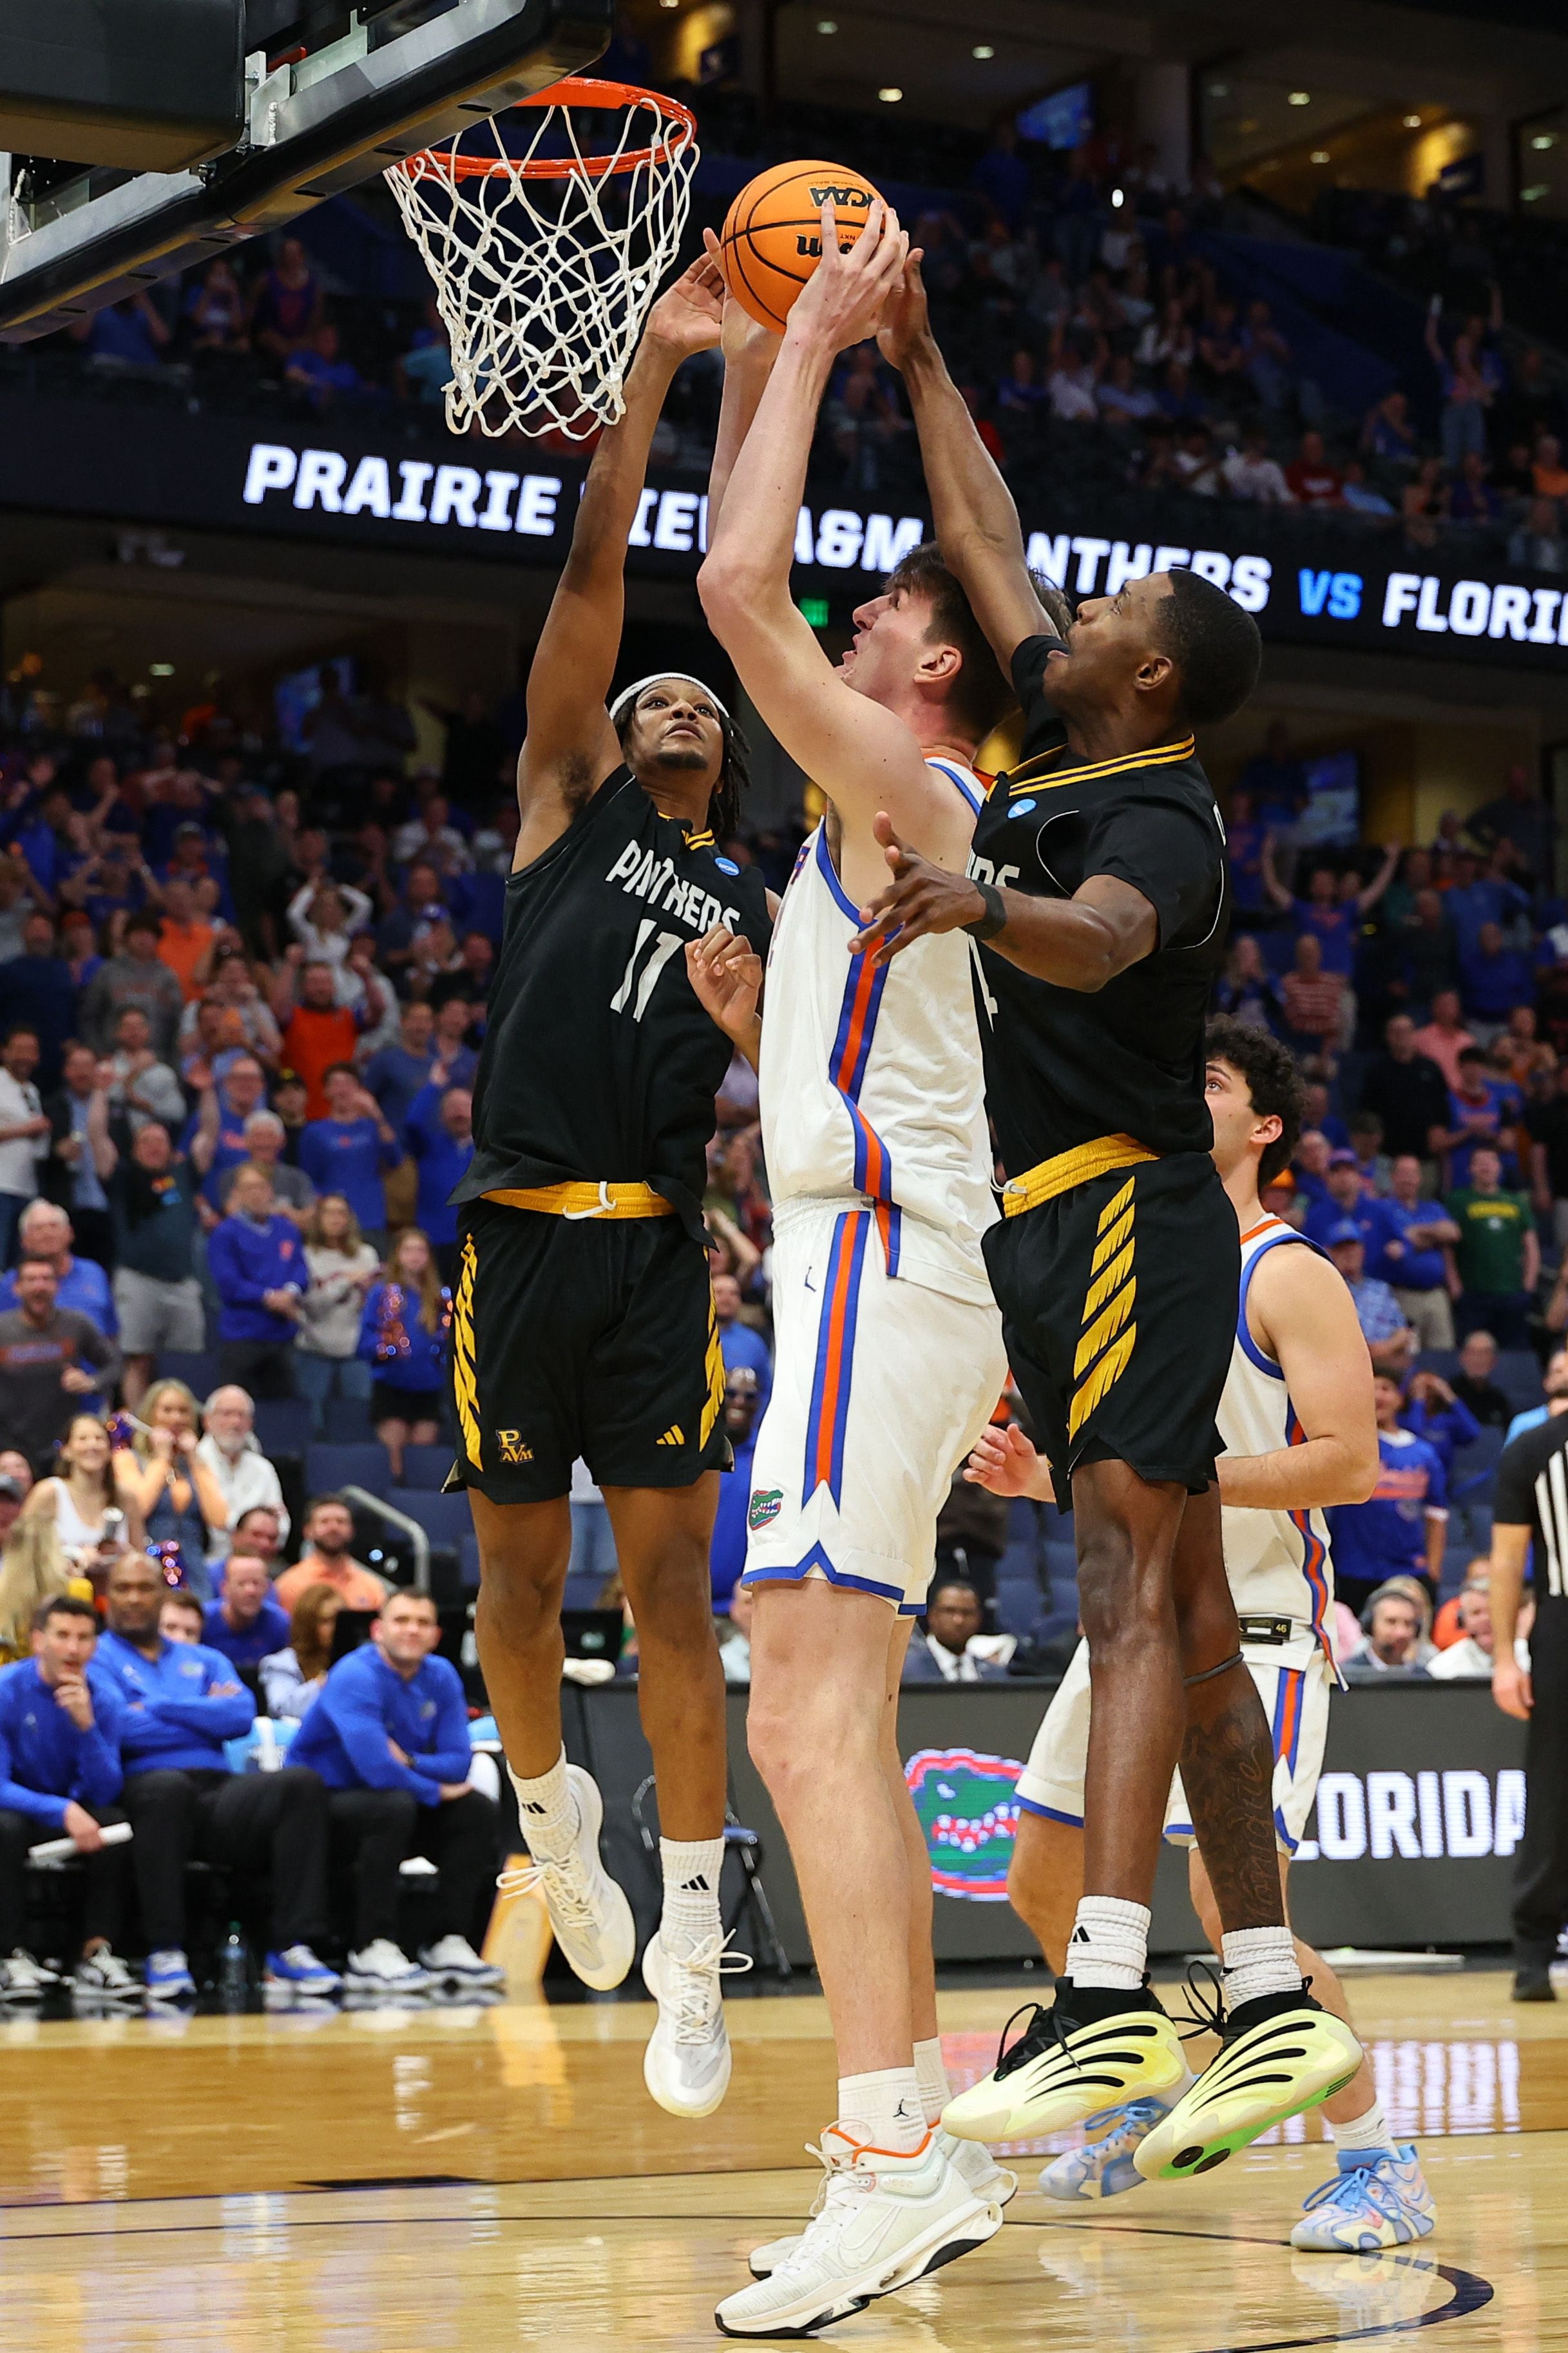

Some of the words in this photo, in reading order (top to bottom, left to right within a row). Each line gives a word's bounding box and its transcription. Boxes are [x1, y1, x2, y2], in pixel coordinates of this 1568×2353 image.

[243, 443, 562, 537] PRAIRIE
[1298, 567, 1364, 619] VS
[1382, 571, 1568, 646] FLORI
[1276, 1623, 1287, 1633] 46
[1290, 1769, 1527, 1861] ORIDA
